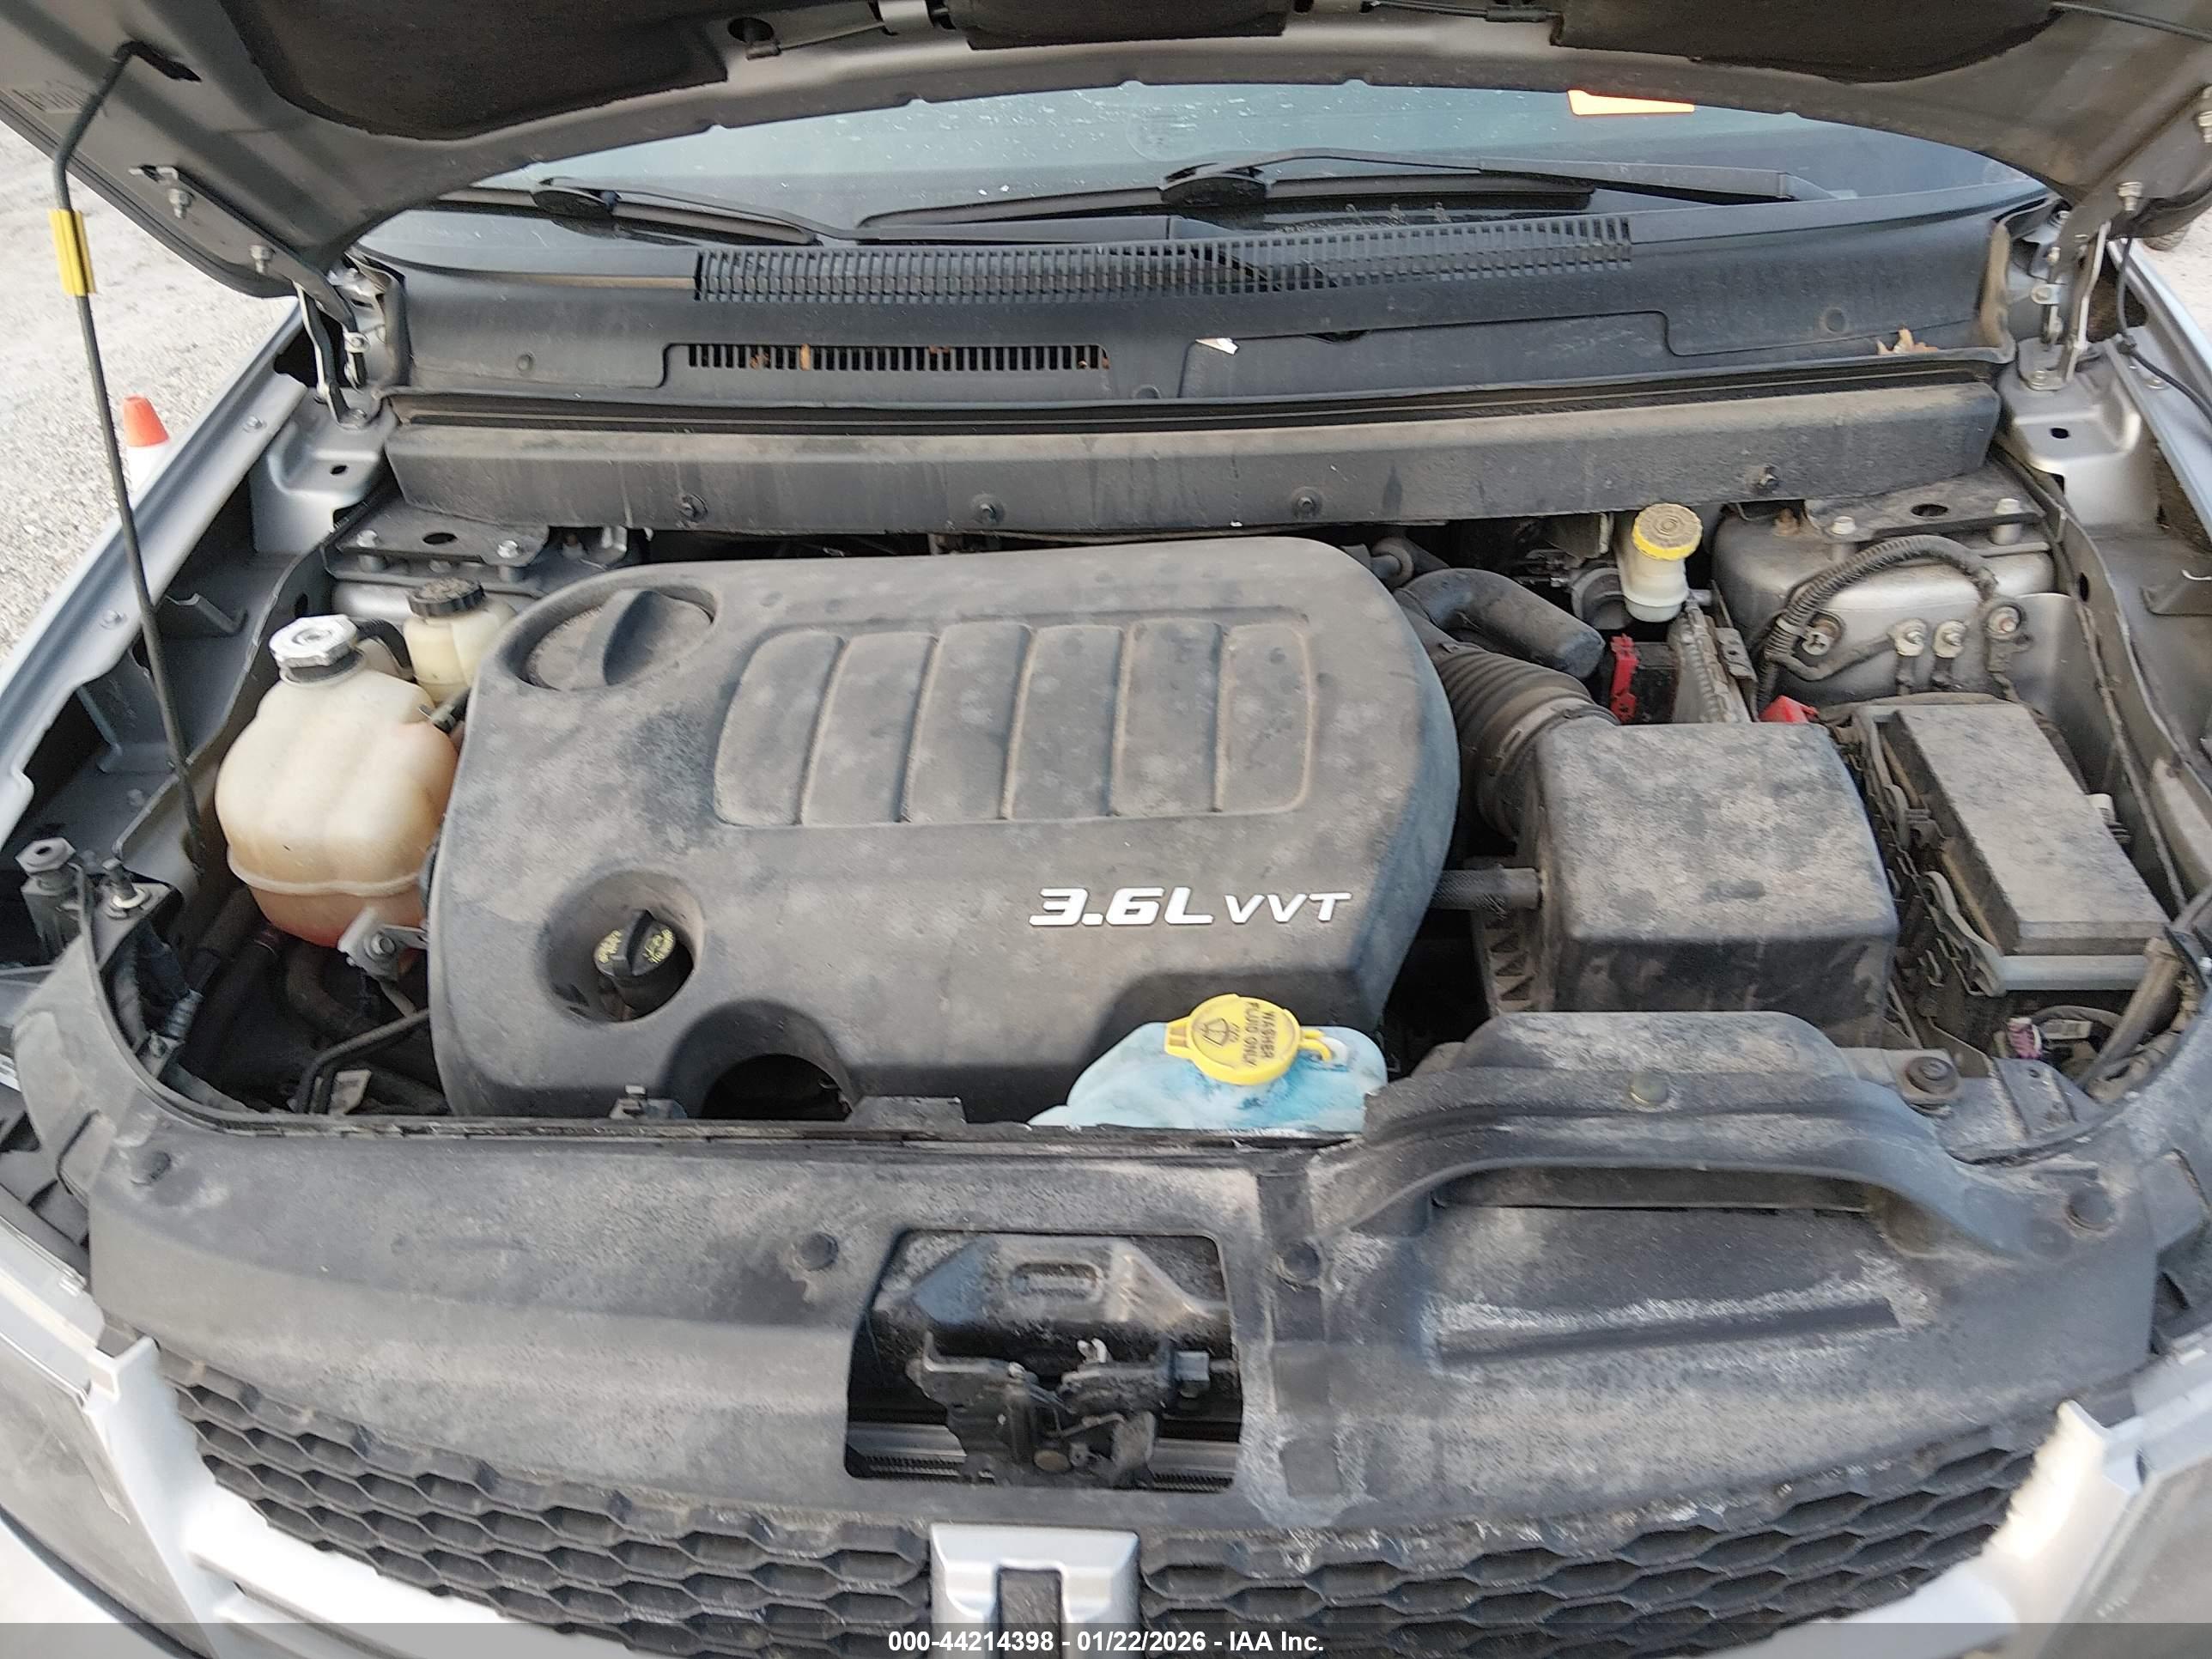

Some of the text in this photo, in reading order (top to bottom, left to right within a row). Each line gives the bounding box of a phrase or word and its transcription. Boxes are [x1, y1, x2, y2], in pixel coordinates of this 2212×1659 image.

[1029, 886, 1352, 927] 3.6L VVT
[1242, 1001, 1260, 1066] FLUID ONLY
[1260, 1011, 1276, 1059] WASHER
